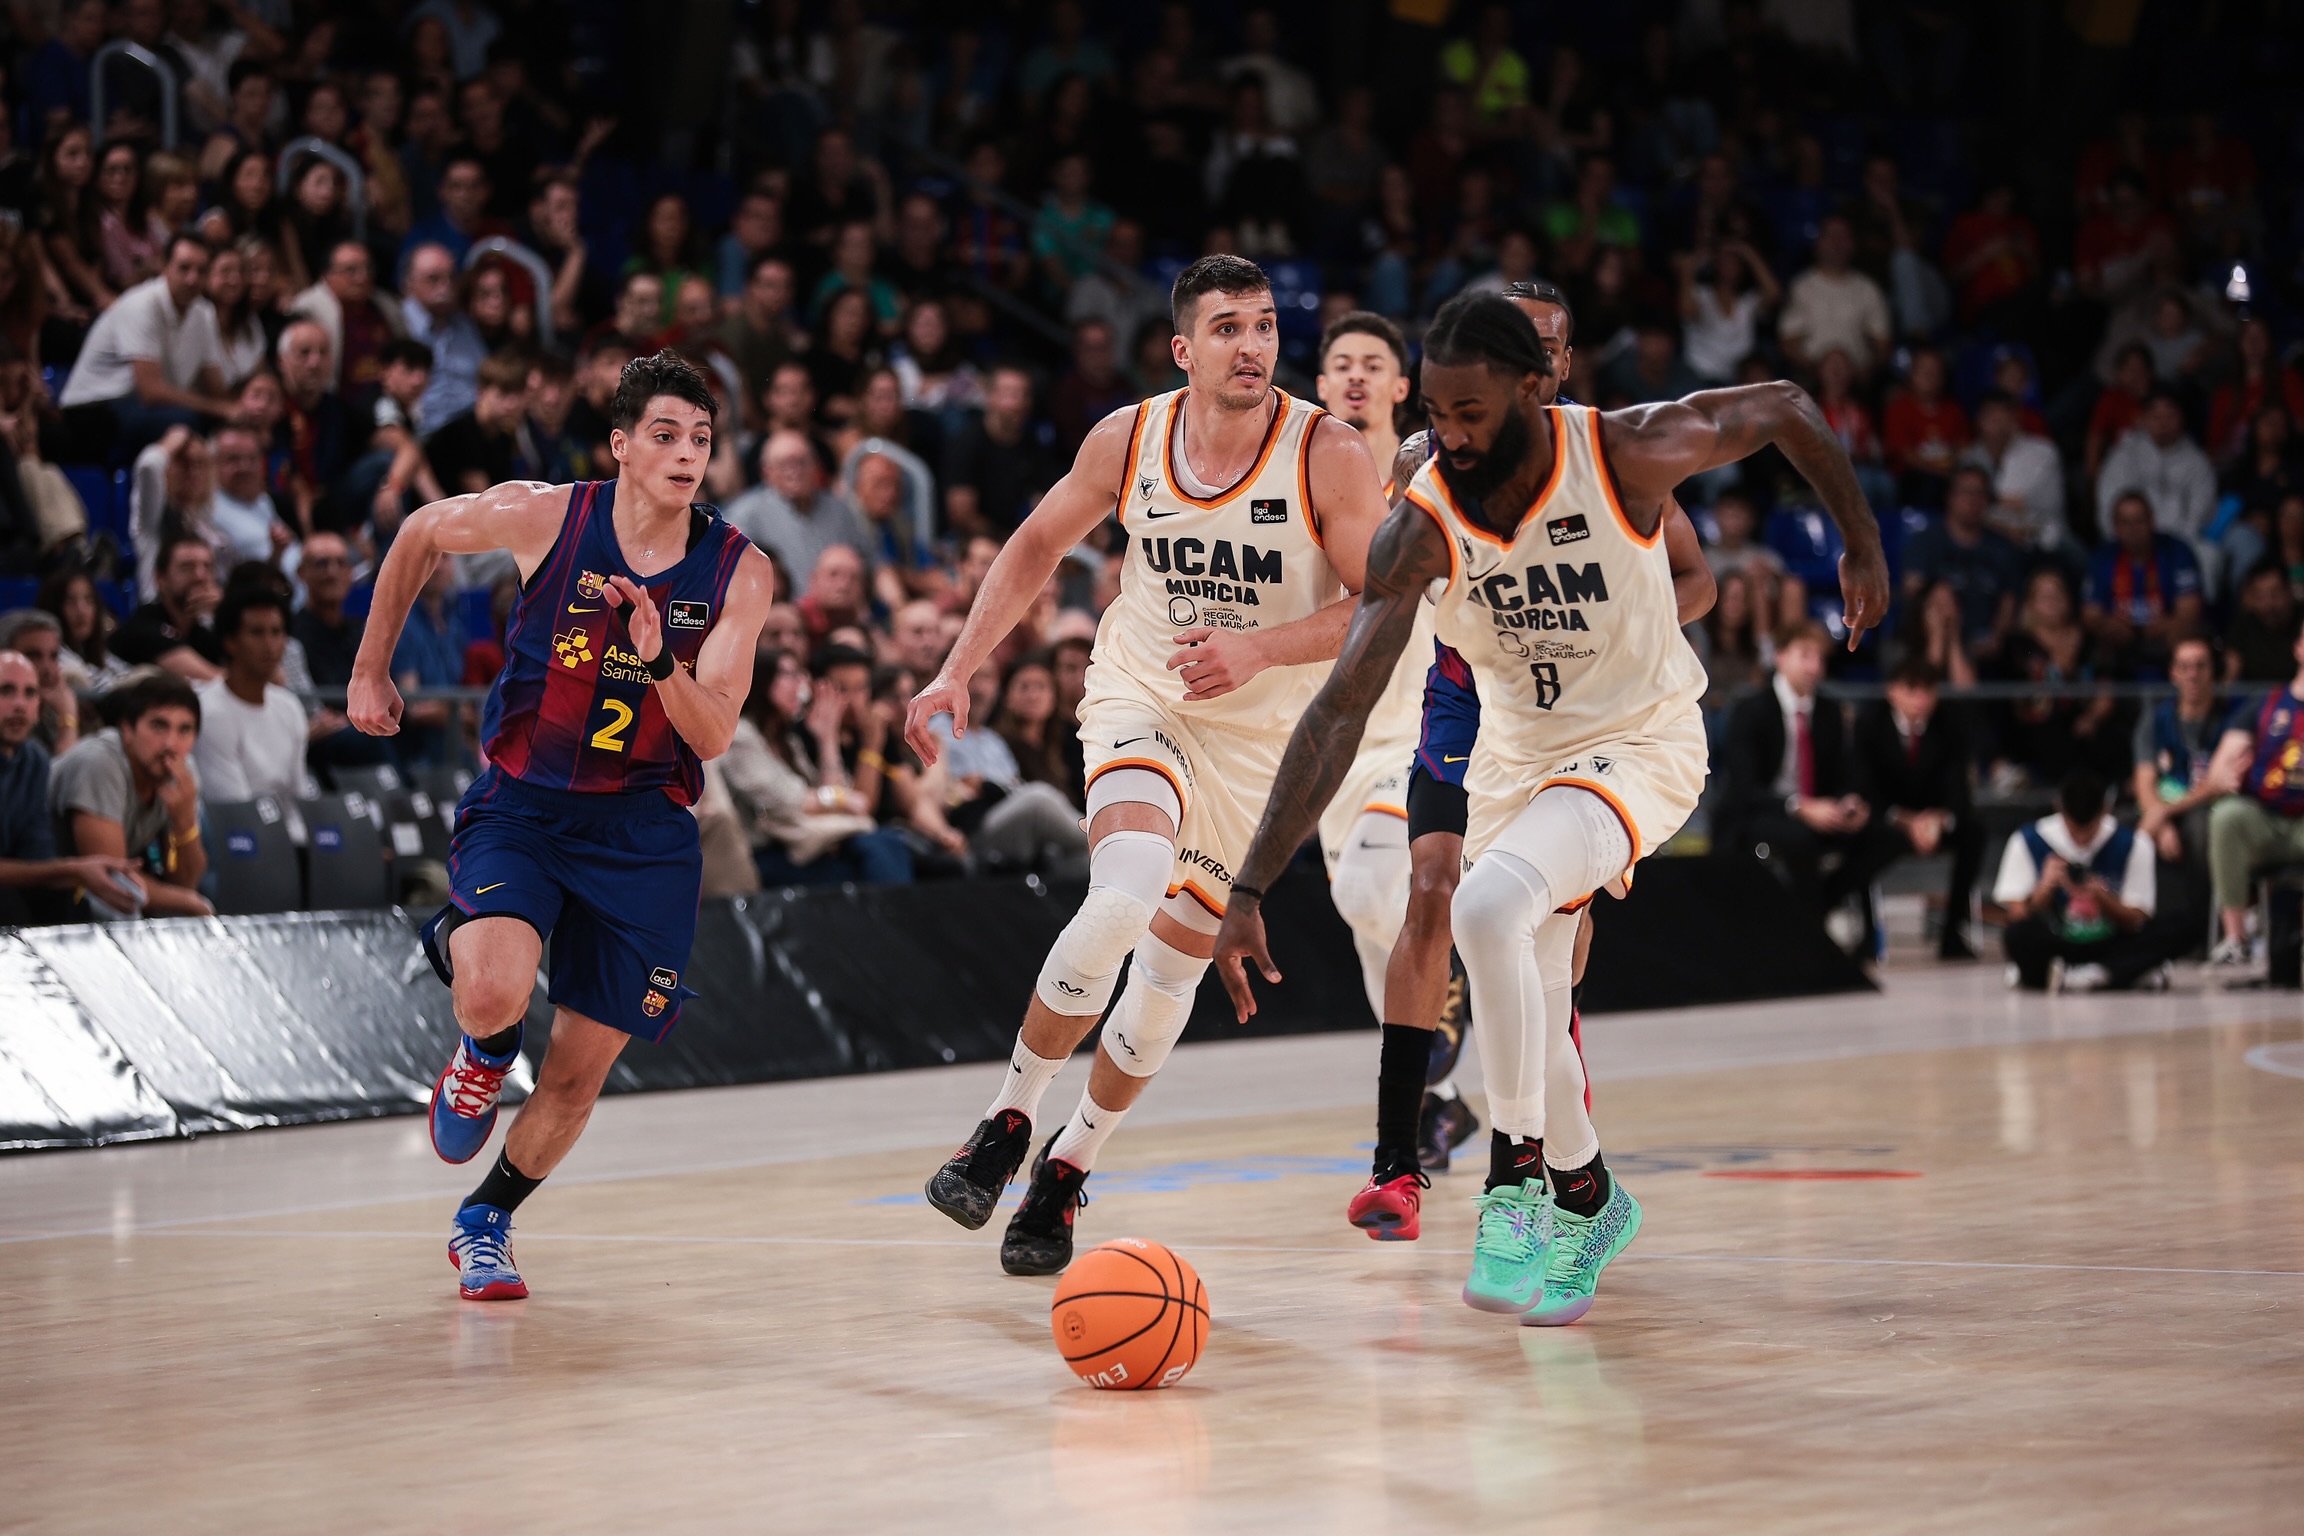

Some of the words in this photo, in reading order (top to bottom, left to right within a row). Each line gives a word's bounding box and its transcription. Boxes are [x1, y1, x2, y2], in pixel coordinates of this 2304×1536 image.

[1253, 506, 1269, 515] liga
[1254, 513, 1286, 521] endesa
[1553, 530, 1588, 543] endesa
[1142, 537, 1282, 584] UCAM
[1165, 578, 1260, 606] MURCIA
[673, 609, 689, 618] liga
[1203, 611, 1242, 622] REGIÓN
[672, 617, 705, 626] endesa
[1204, 618, 1217, 627] DE
[1220, 620, 1259, 631] MURCIA
[1549, 649, 1596, 659] MURCIA
[591, 698, 634, 752] 2
[653, 974, 672, 986] acb
